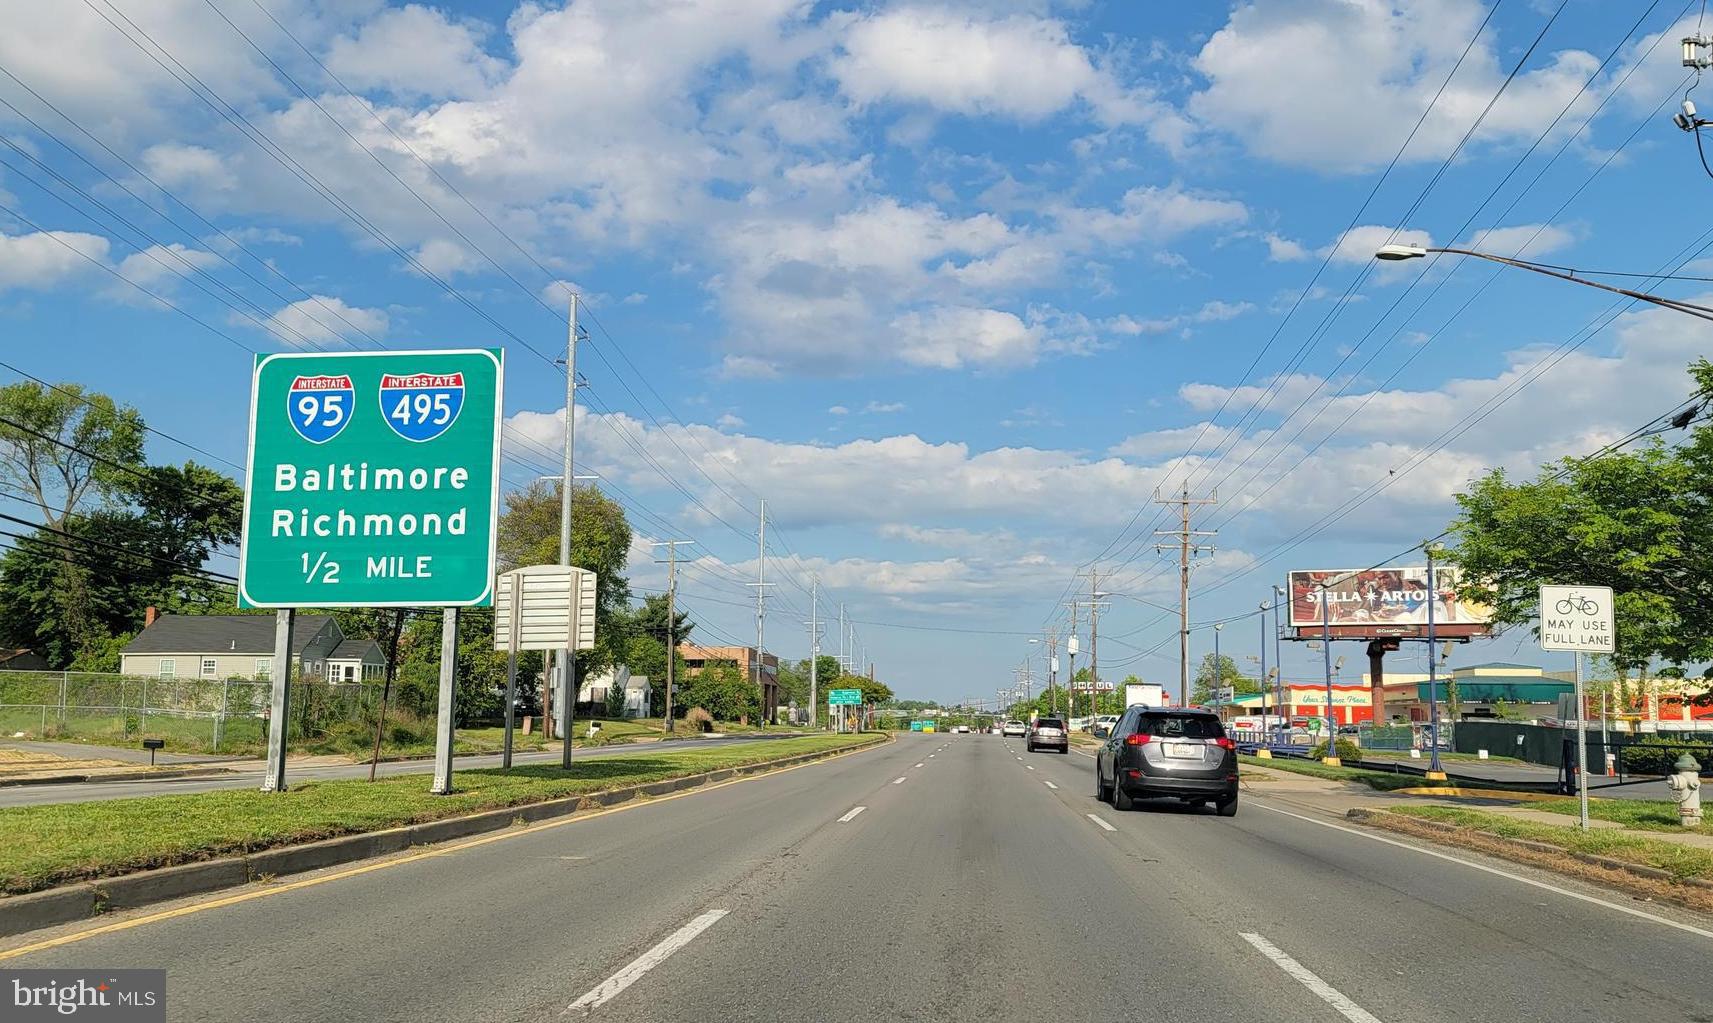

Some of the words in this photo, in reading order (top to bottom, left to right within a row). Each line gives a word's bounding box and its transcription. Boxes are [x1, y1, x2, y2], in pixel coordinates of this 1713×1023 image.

[298, 378, 346, 389] INTERSTATE
[388, 376, 457, 387] INTERSTATE
[298, 395, 344, 428] 95
[391, 393, 451, 426] 495
[274, 462, 469, 492] Baltimore
[272, 507, 467, 537] Richmond
[367, 556, 432, 578] MILE
[1306, 591, 1362, 602] STELLA
[1380, 590, 1440, 602] ARTOIS
[1547, 619, 1574, 629] MAY
[1582, 620, 1607, 631] USE
[1545, 634, 1575, 644] FULL
[1580, 635, 1611, 646] LANE
